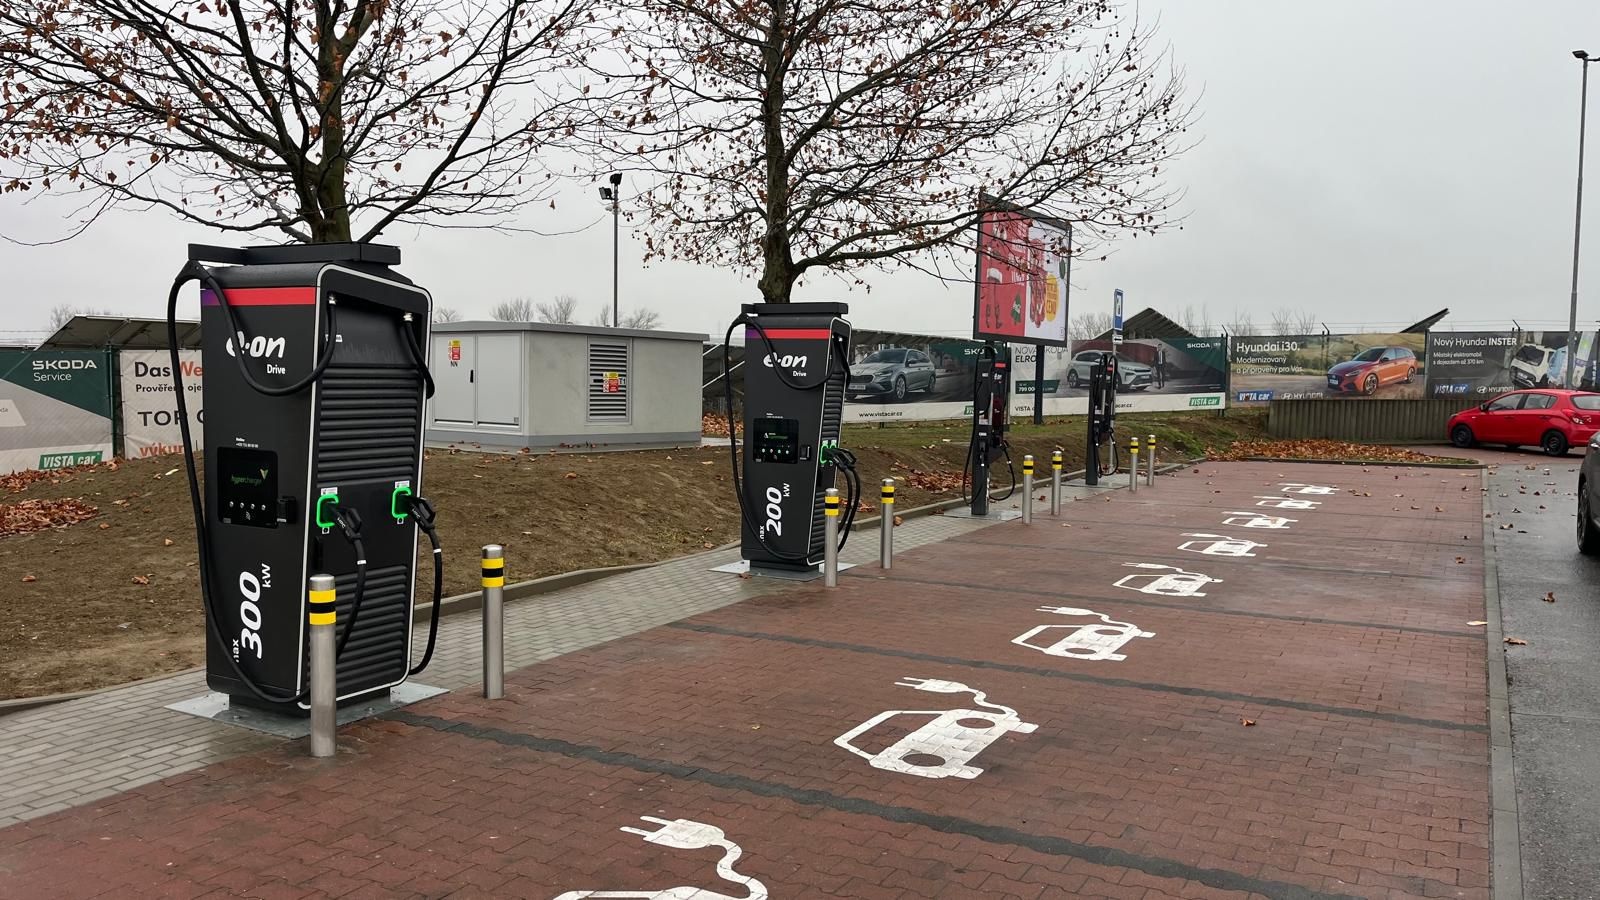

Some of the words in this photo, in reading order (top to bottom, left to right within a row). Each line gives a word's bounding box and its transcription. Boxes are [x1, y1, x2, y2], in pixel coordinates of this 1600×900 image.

[1236, 342, 1280, 354] Hyundai
[1281, 341, 1300, 352] i30.
[1433, 337, 1453, 347] Nový
[1455, 338, 1487, 347] Hyundai
[1488, 338, 1517, 346] INSTER
[1236, 355, 1287, 364] Modernizovaný
[134, 361, 171, 378] Das
[266, 363, 286, 375] Drive
[33, 372, 72, 382] Service
[135, 383, 184, 393] Prověře
[1191, 398, 1207, 406] VISTA
[43, 455, 74, 469] VISTA
[77, 455, 96, 466] car
[766, 486, 782, 537] 200
[783, 482, 791, 497] kW
[239, 571, 263, 659] 300
[261, 563, 271, 588] kW
